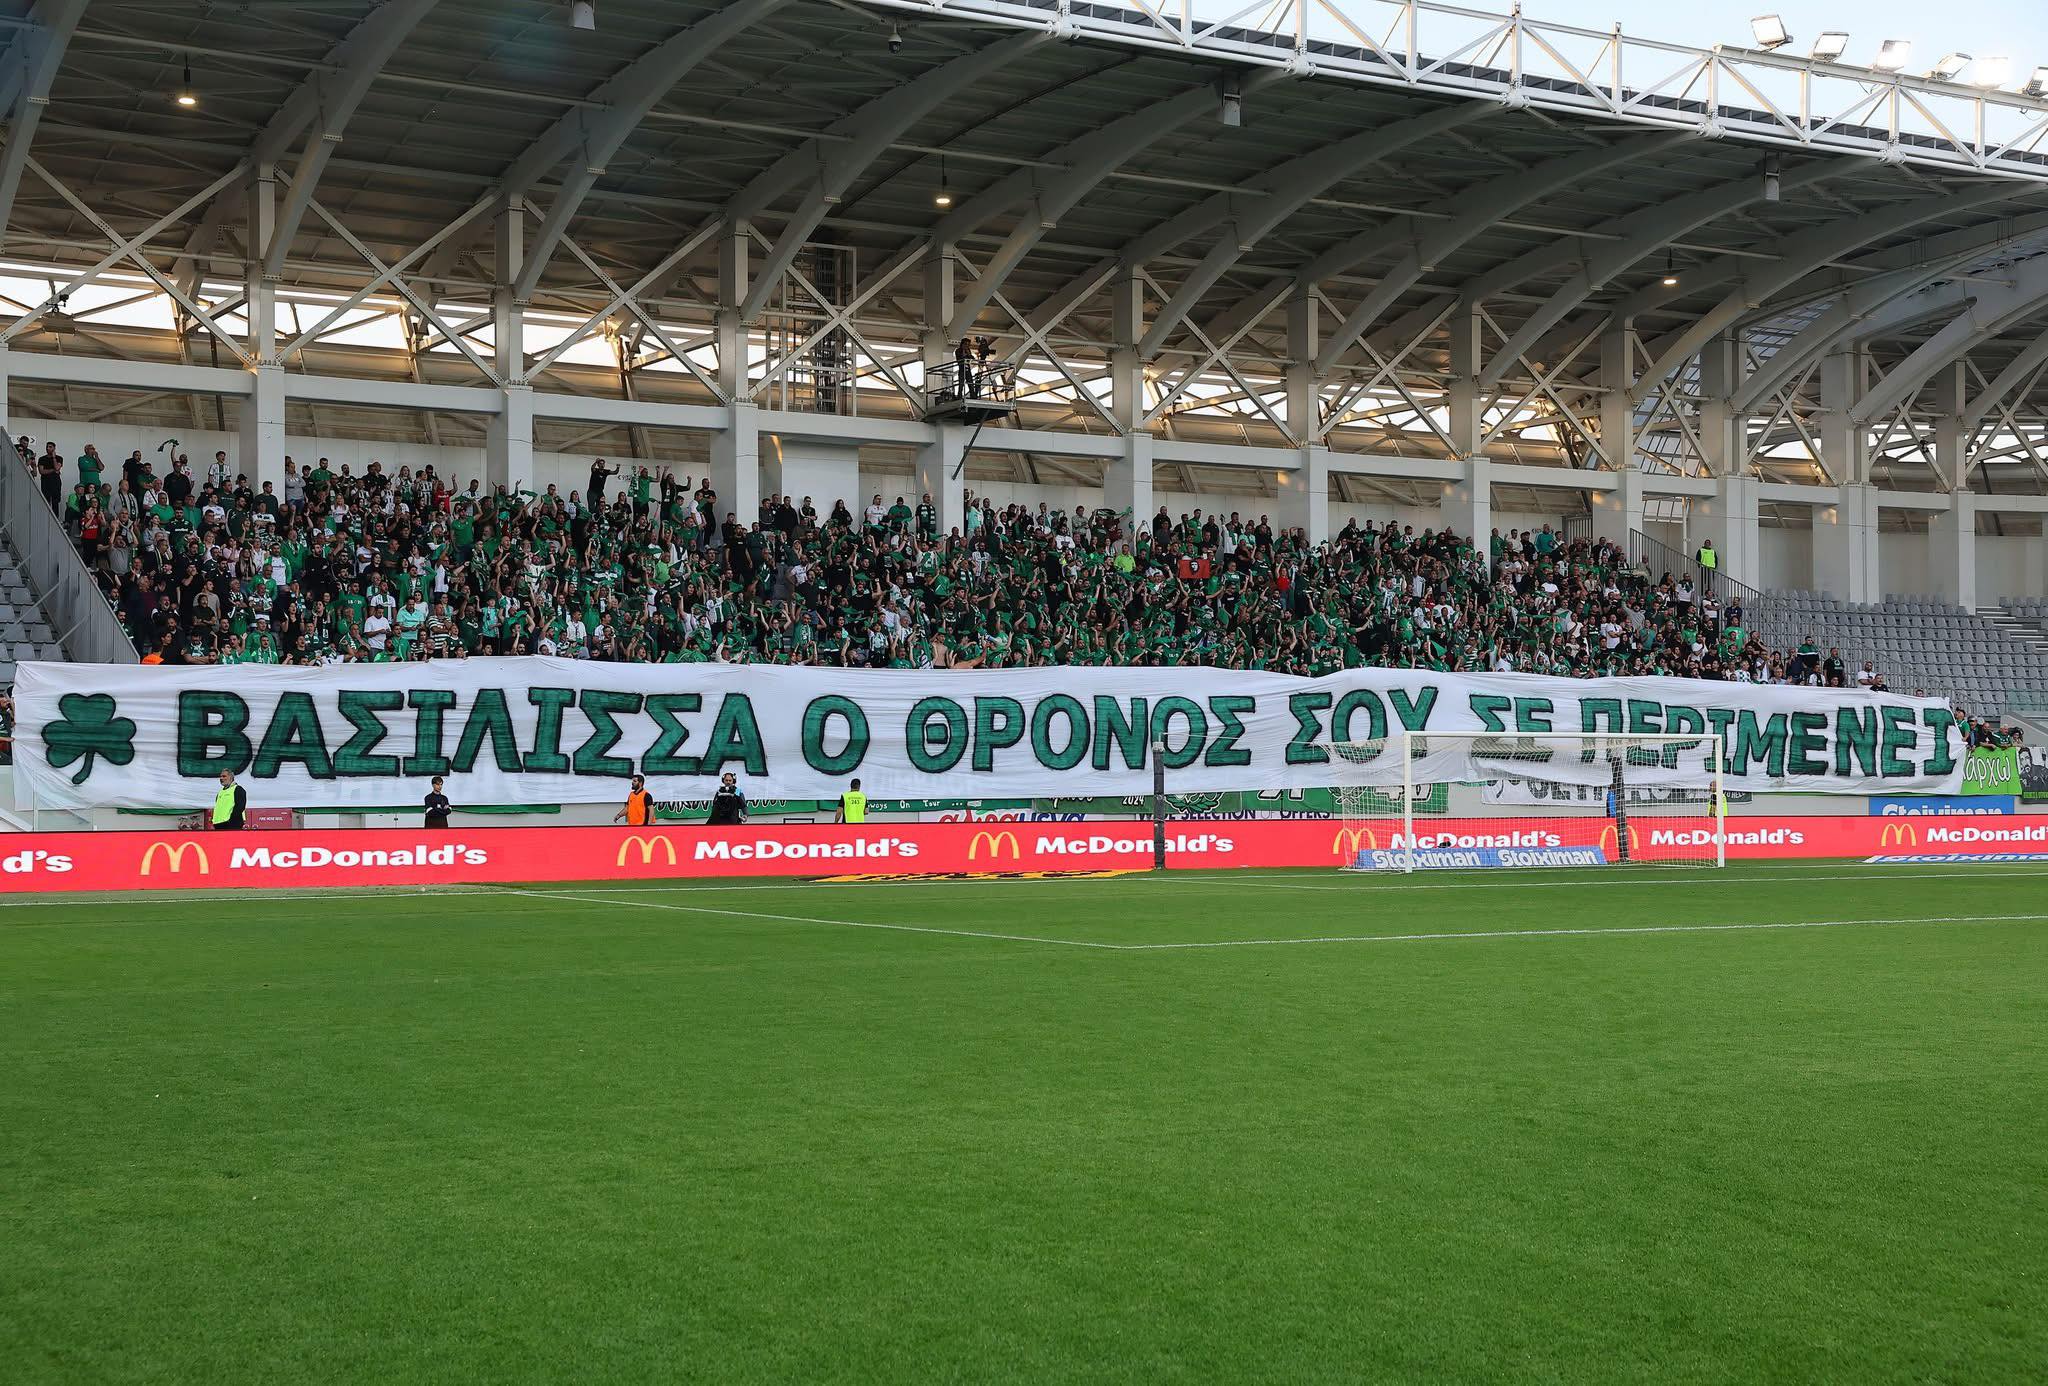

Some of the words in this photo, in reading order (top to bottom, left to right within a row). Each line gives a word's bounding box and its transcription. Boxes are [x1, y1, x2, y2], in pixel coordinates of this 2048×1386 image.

[176, 687, 769, 779] ΒΑΣΙΛΙΣΣΑ
[801, 694, 870, 774] Ο
[905, 693, 1256, 773] ΘΡΟΝΟΣ
[1285, 686, 1439, 765] ΣΟΥ
[1469, 694, 1554, 763] ΣΕ
[1578, 697, 1957, 778] ΠΕΡΙΜΕΝΕΙ
[900, 800, 911, 809] On
[1035, 834, 1234, 854] McDonald's
[1391, 831, 1561, 849] McDonald's
[1650, 828, 1804, 846] McDonald's
[229, 843, 488, 869] McDonald's
[693, 837, 919, 860] McDonald's
[1499, 849, 1597, 867] Stoiximan
